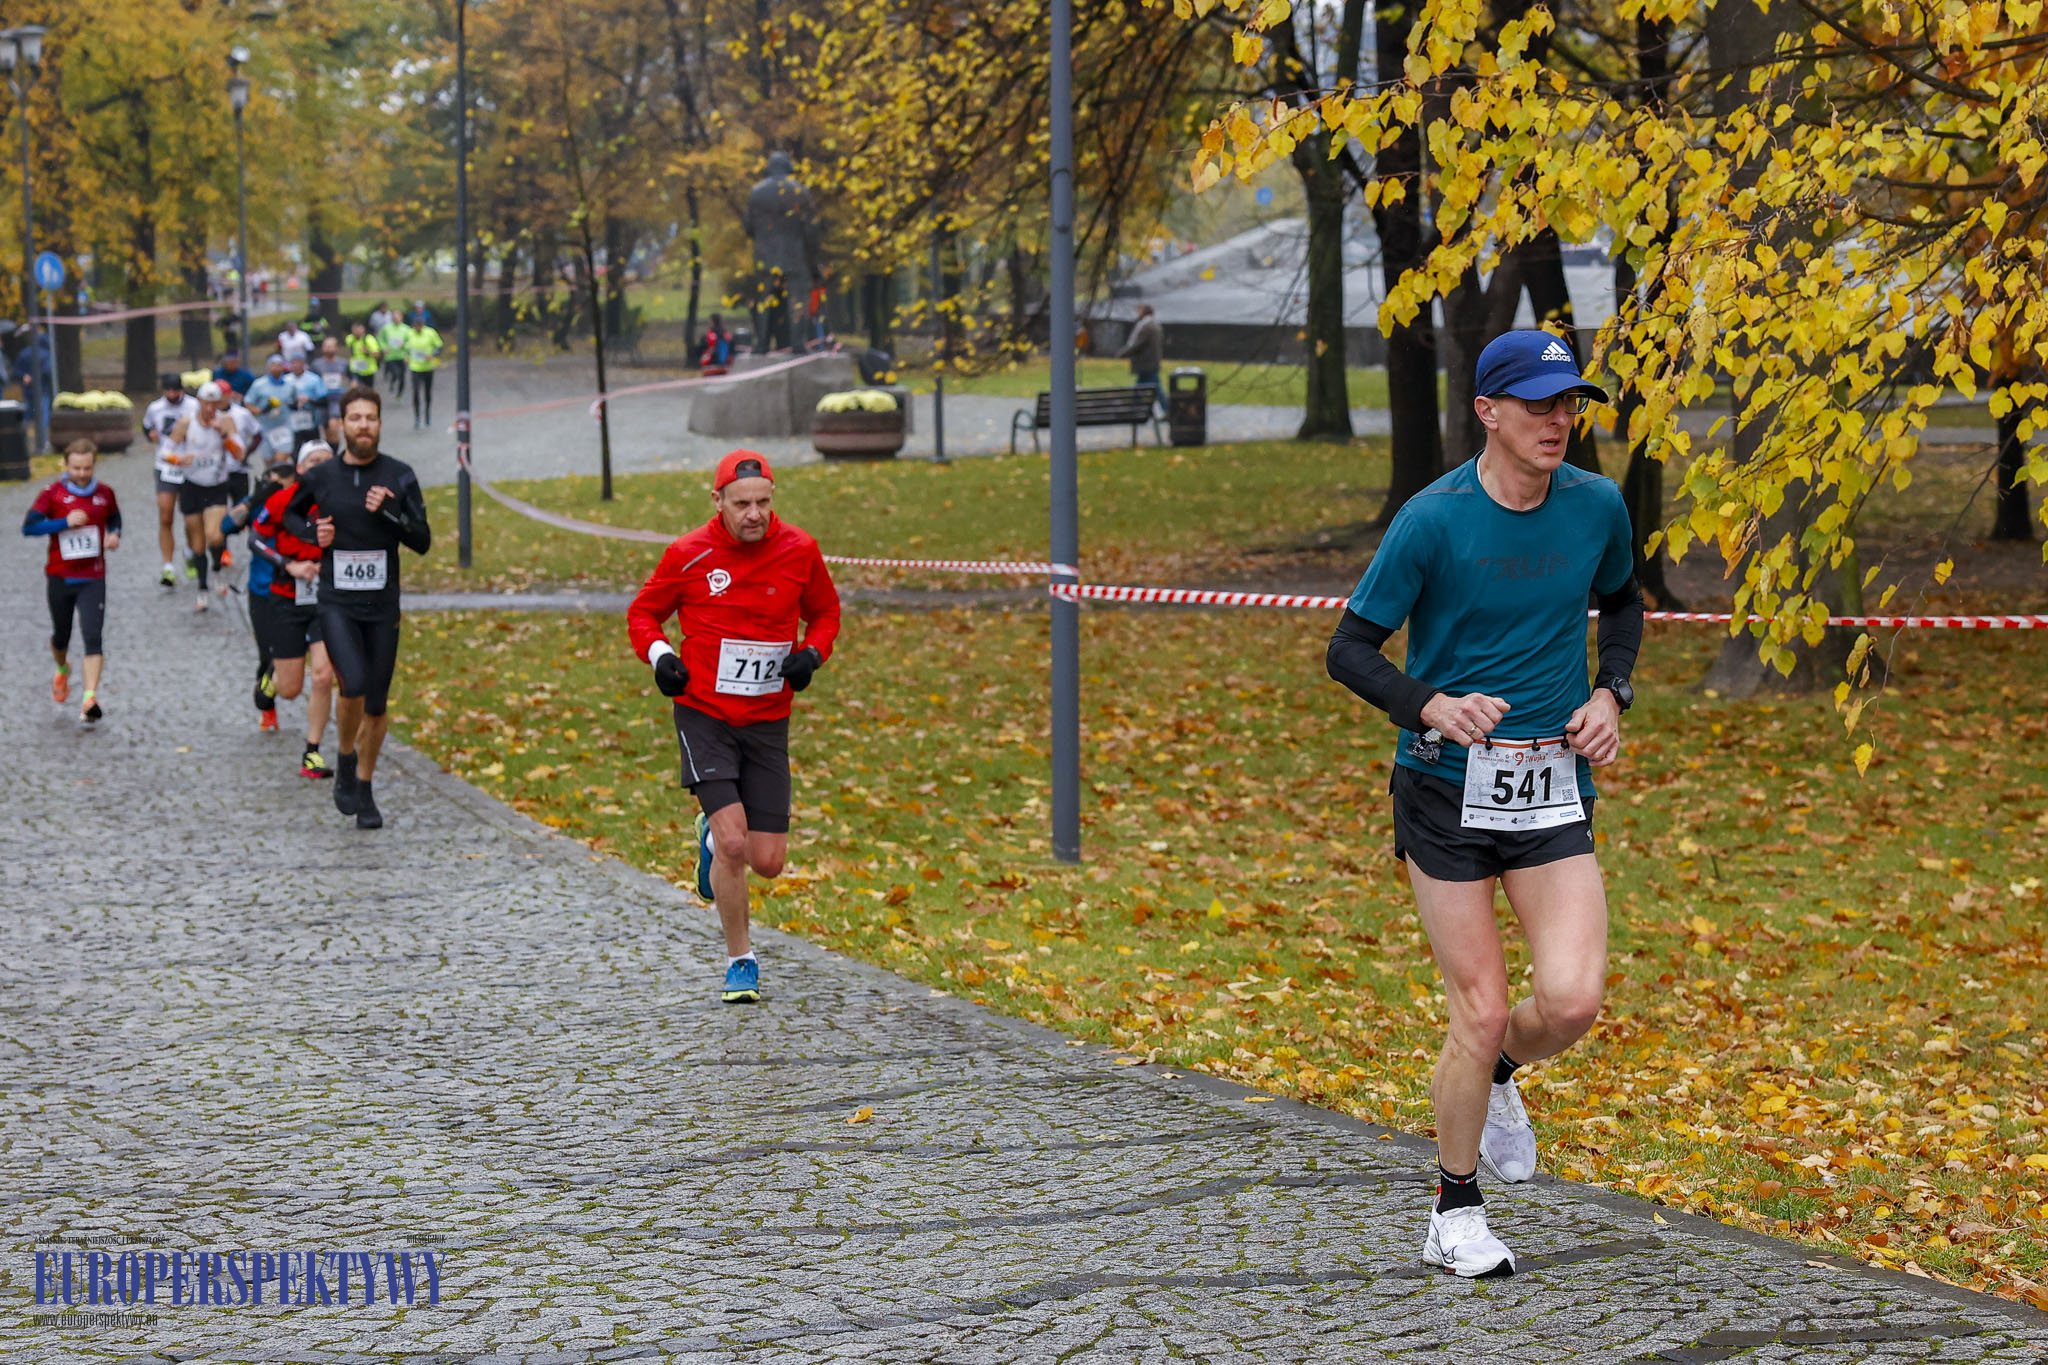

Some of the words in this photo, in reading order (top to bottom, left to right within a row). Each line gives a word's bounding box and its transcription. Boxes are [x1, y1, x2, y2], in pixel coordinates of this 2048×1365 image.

[1541, 353, 1571, 362] adidas
[344, 563, 376, 580] 468
[735, 658, 776, 680] 712
[1514, 751, 1525, 766] 9
[1491, 766, 1552, 805] 541
